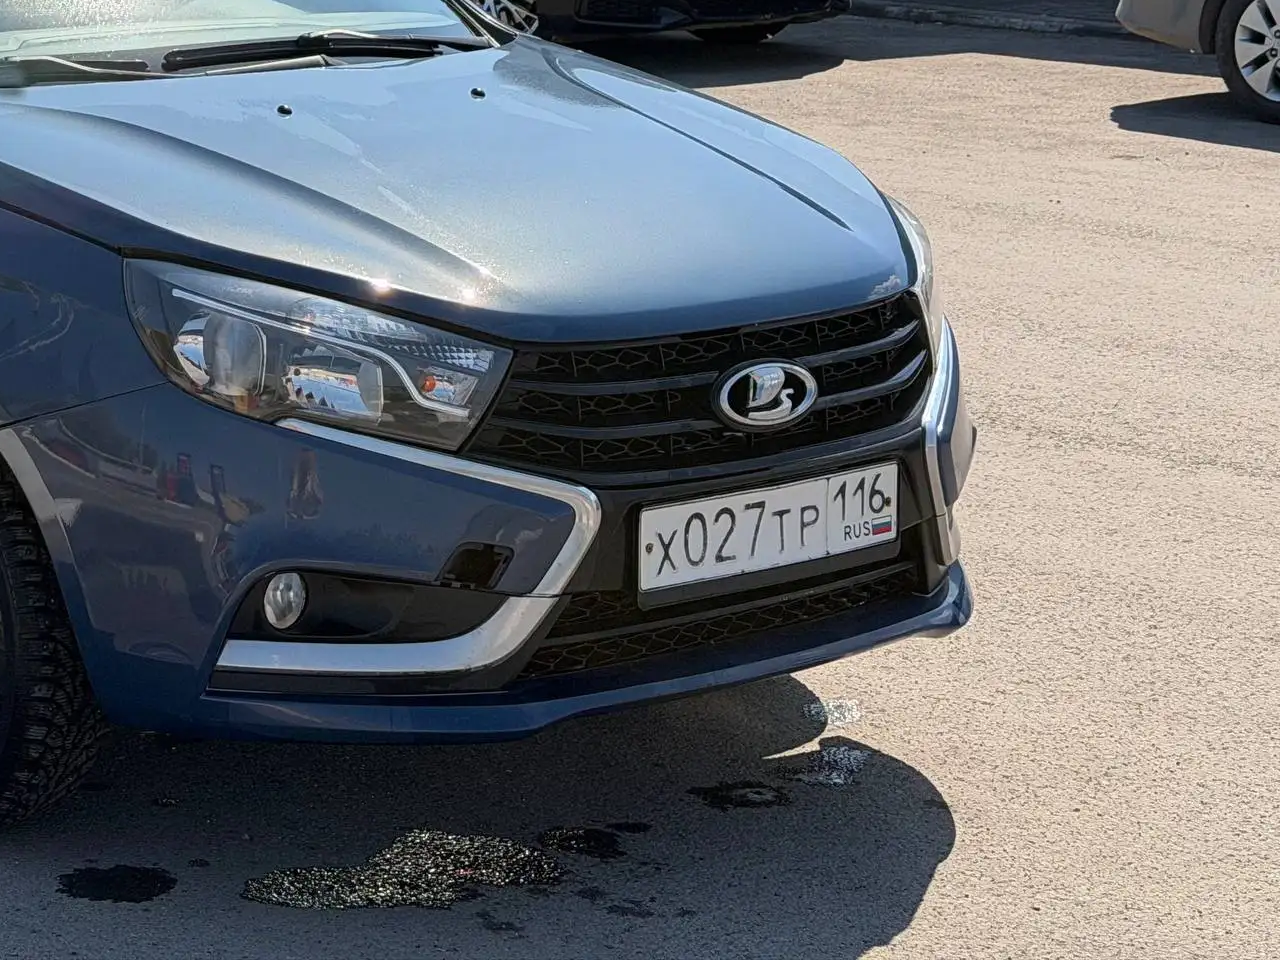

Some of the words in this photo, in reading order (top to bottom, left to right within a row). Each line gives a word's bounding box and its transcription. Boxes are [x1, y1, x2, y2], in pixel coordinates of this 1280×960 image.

[656, 500, 820, 576] Х027ТР
[833, 473, 886, 521] 116
[844, 521, 870, 541] RUS
